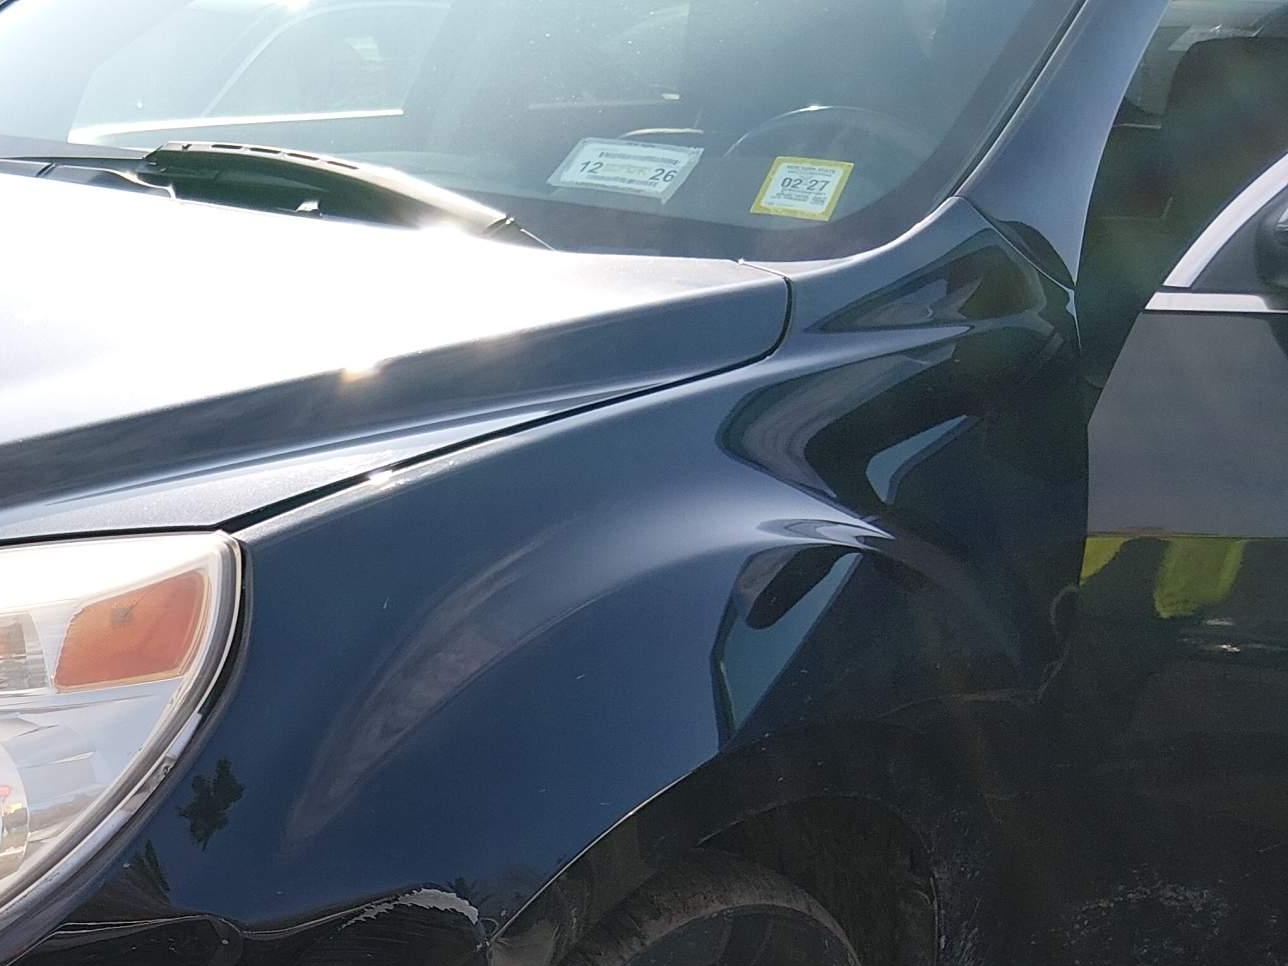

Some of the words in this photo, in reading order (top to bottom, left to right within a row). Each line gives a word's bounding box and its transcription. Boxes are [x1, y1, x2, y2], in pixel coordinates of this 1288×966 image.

[579, 160, 604, 174] 12
[648, 167, 677, 183] 26
[780, 177, 803, 189] 02
[806, 179, 831, 191] 27
